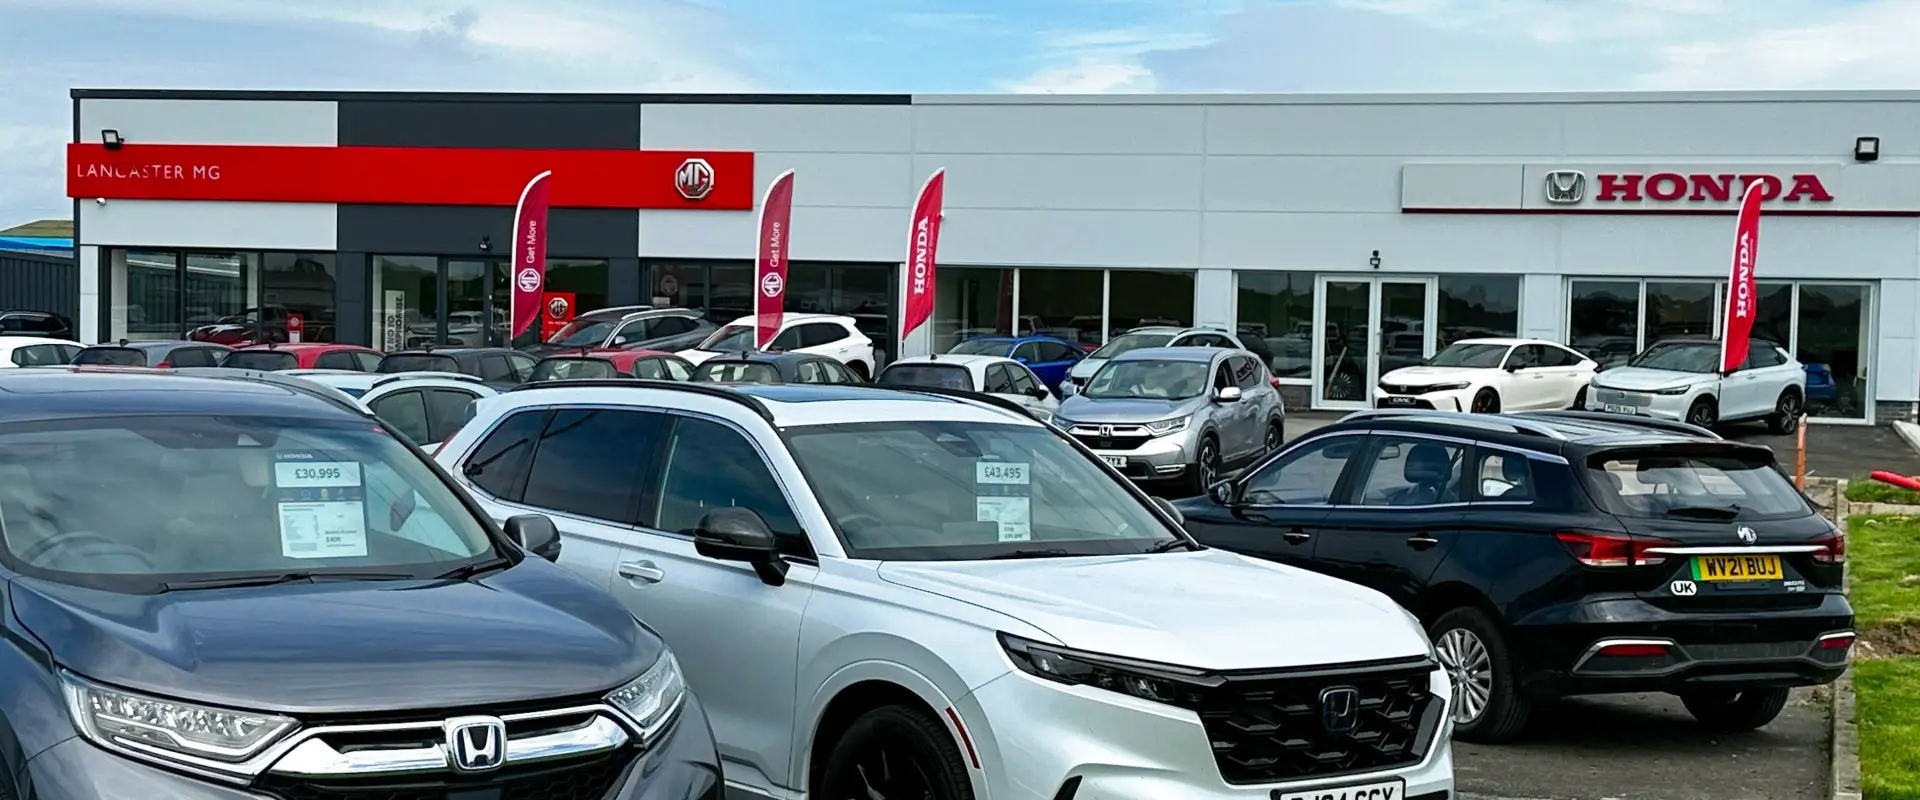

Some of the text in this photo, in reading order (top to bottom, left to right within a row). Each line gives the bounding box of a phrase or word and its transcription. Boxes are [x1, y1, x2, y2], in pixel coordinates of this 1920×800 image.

[77, 163, 221, 180] LANCASTER MG
[677, 161, 711, 196] MG
[1596, 173, 1834, 201] HONDA
[526, 220, 537, 264] Get More
[769, 221, 781, 268] Get More
[914, 216, 929, 295] HONDA
[519, 269, 539, 291] MG
[763, 274, 782, 296] MG
[1736, 230, 1749, 318] HONDA
[549, 299, 567, 317] MG
[295, 467, 341, 480] £30,995
[984, 466, 1022, 479] £43,495
[1706, 555, 1777, 577] WV21 BUJ
[1673, 582, 1694, 594] UK
